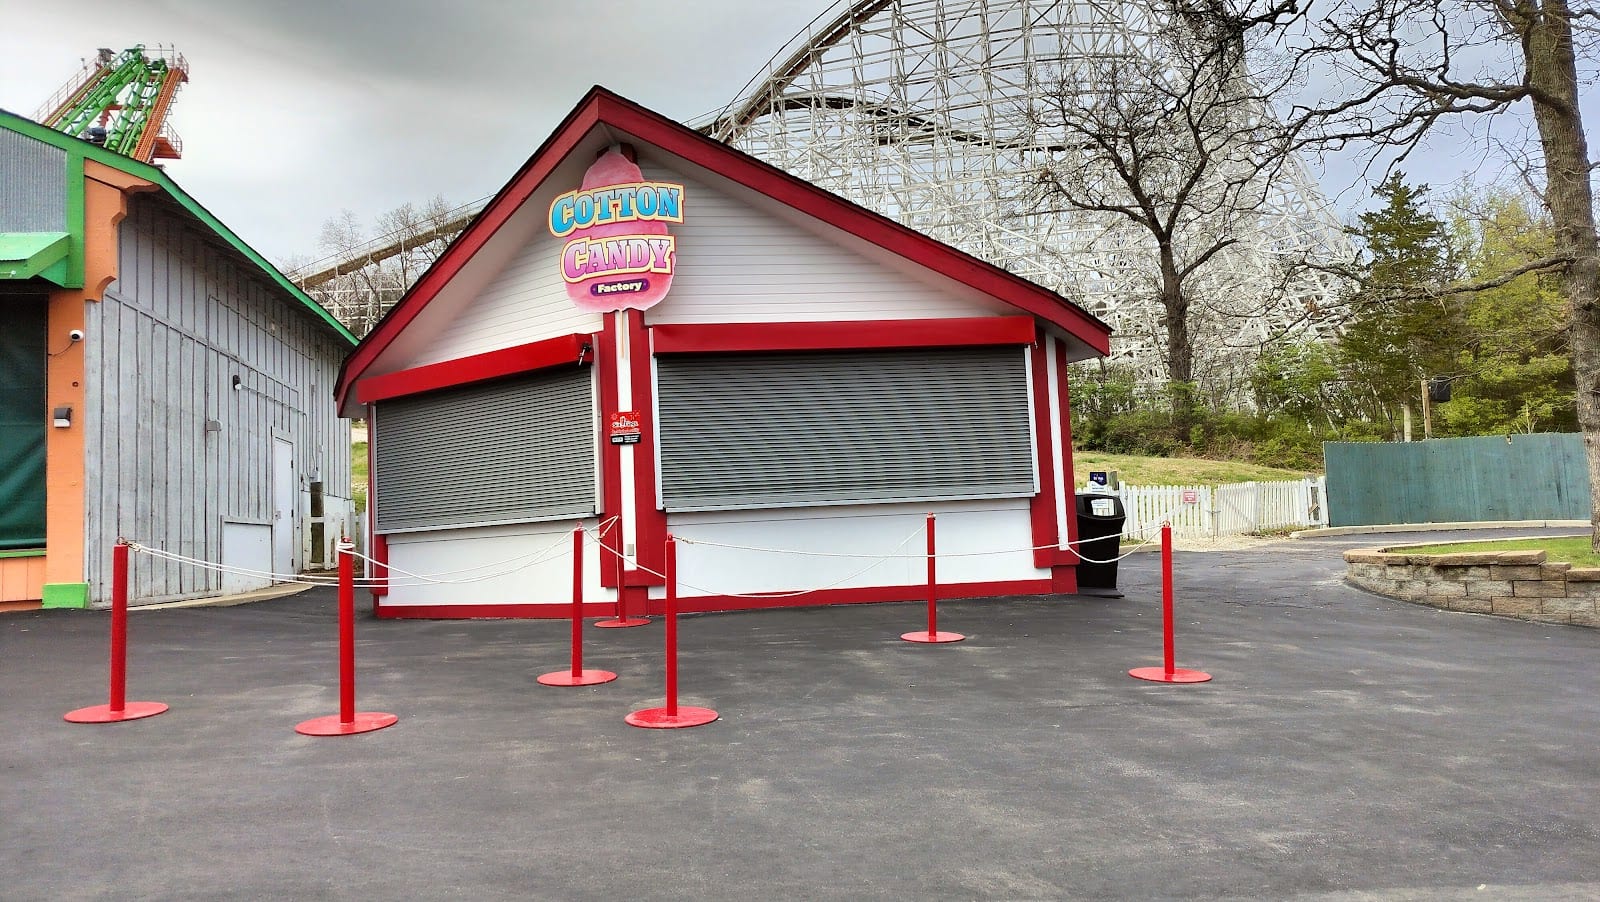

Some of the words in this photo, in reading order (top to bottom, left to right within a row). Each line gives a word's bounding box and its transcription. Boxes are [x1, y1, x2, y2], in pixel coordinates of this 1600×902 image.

[551, 185, 680, 234] COTTON
[563, 238, 671, 278] CANDY
[597, 281, 643, 294] Factory
